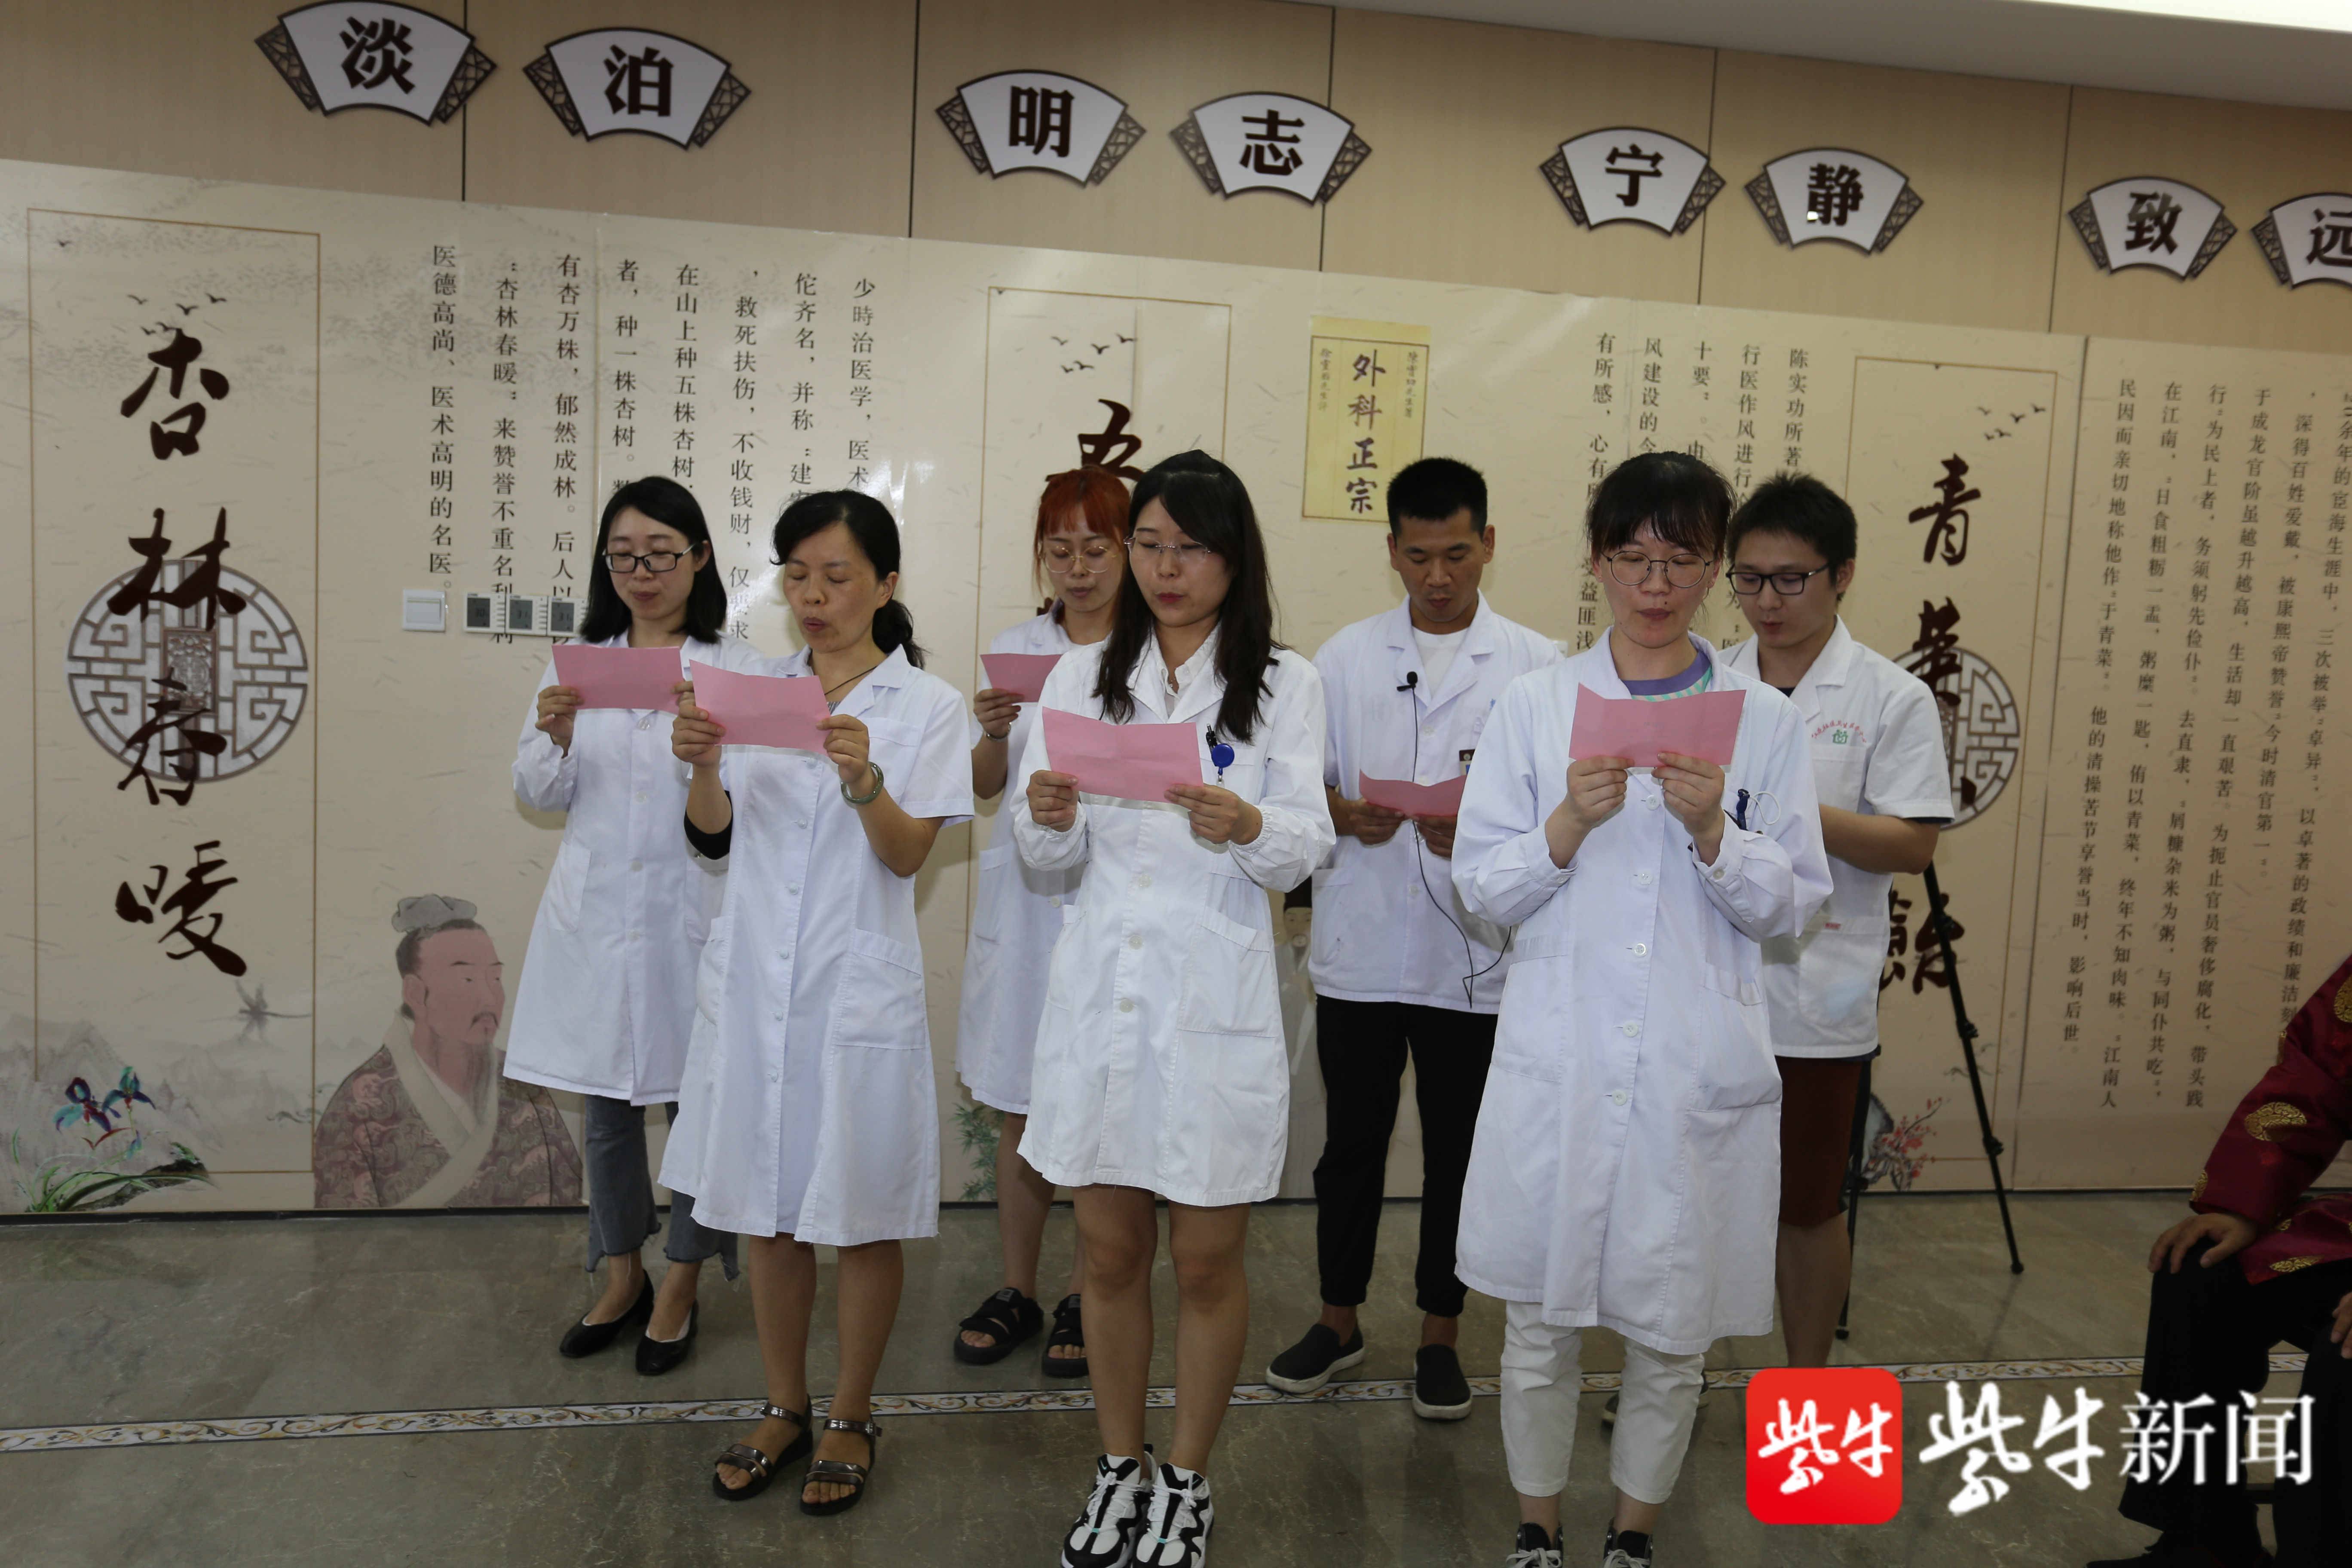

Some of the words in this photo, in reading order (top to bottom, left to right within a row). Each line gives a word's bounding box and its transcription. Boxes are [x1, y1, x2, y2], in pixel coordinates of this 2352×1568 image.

[339, 16, 415, 94] 淡
[603, 44, 674, 117] 泊
[1008, 86, 1075, 157] 明
[1239, 109, 1305, 175] 志
[1605, 145, 1664, 207] 宁
[1807, 164, 1864, 227] 静
[2125, 191, 2178, 254] 致
[2306, 208, 2352, 266] 远
[1345, 349, 1387, 513] 外科正宗
[1733, 344, 1761, 505] 行医作风进行
[107, 329, 247, 976] 杏林春暖
